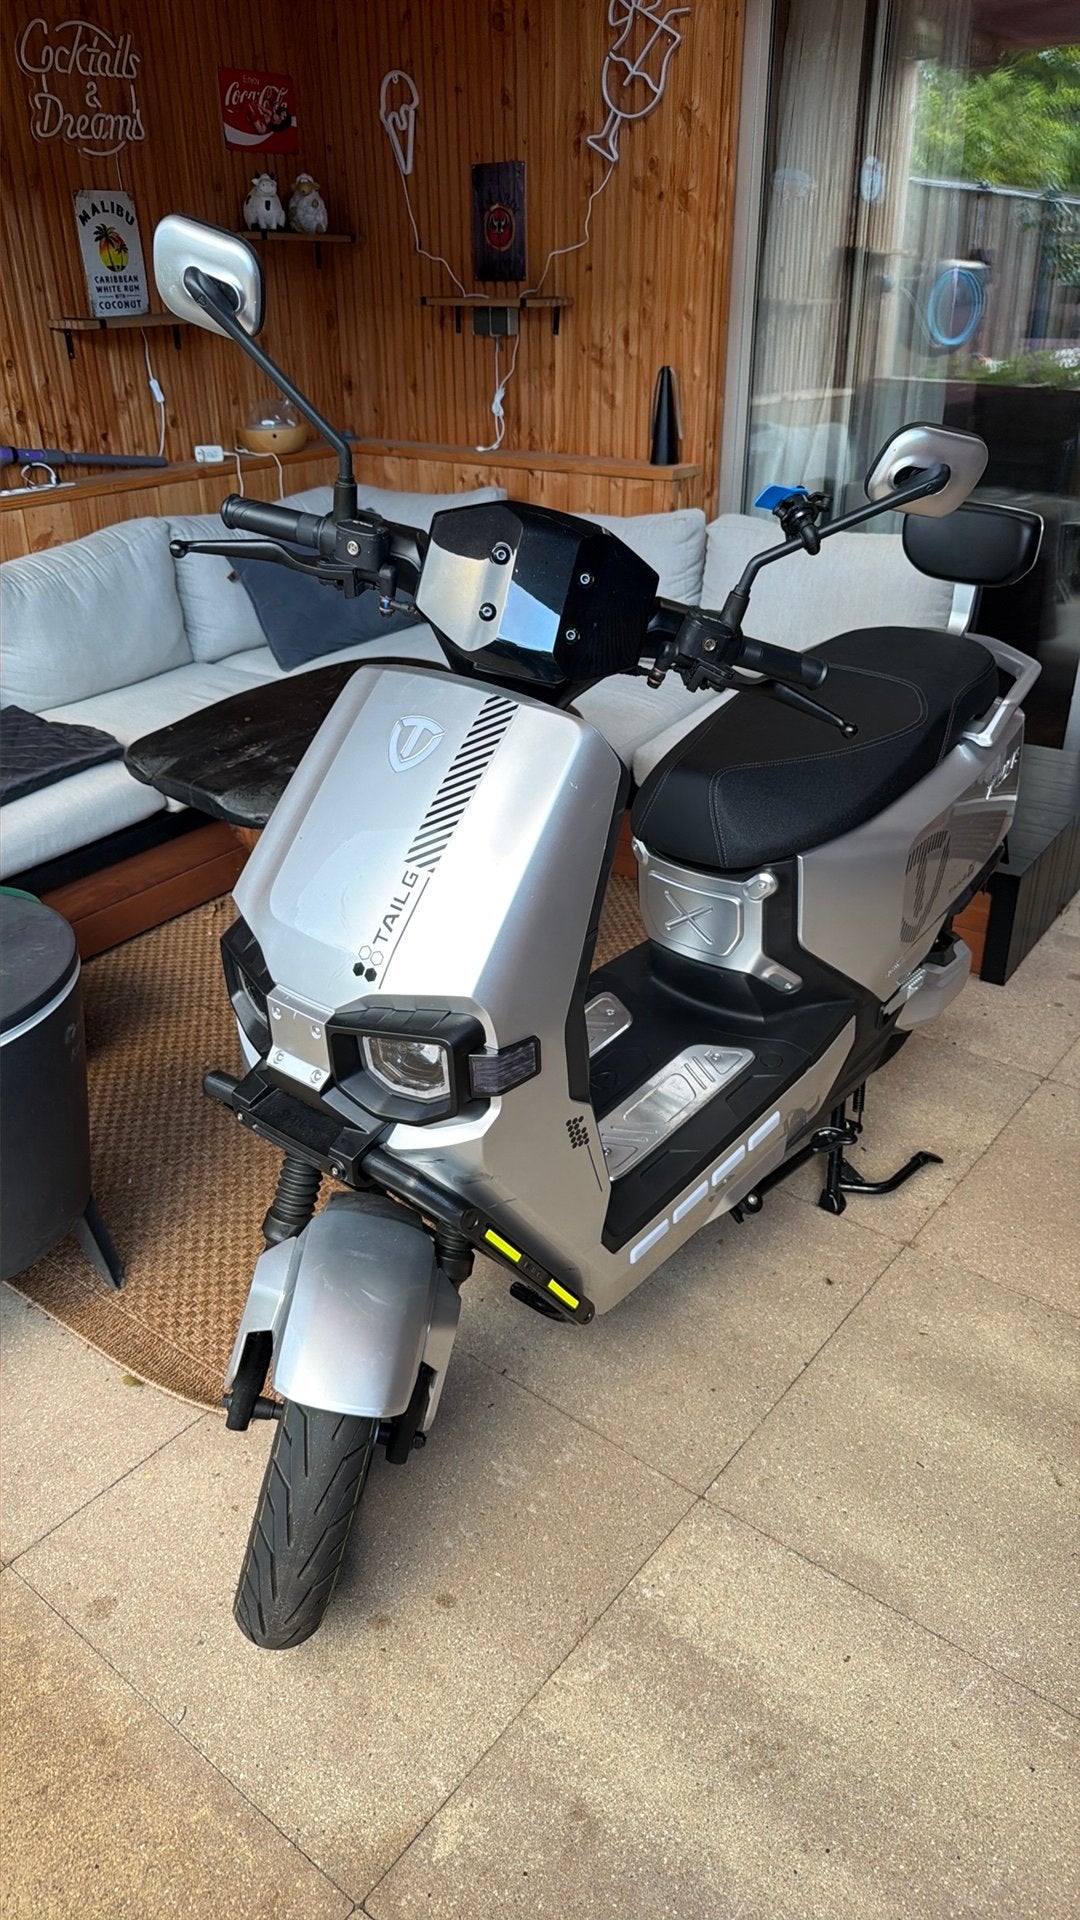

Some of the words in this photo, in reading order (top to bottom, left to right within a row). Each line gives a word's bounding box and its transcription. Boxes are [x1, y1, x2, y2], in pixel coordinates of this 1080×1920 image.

[20, 18, 141, 79] Cocktails
[85, 81, 102, 108] &
[34, 92, 145, 139] Dreams
[79, 200, 135, 227] MALIBU
[94, 275, 139, 284] CARIBBEAN
[95, 285, 121, 293] WHITE
[124, 284, 140, 292] RUM
[99, 299, 142, 310] COCONUT
[373, 870, 419, 945] TAILG
